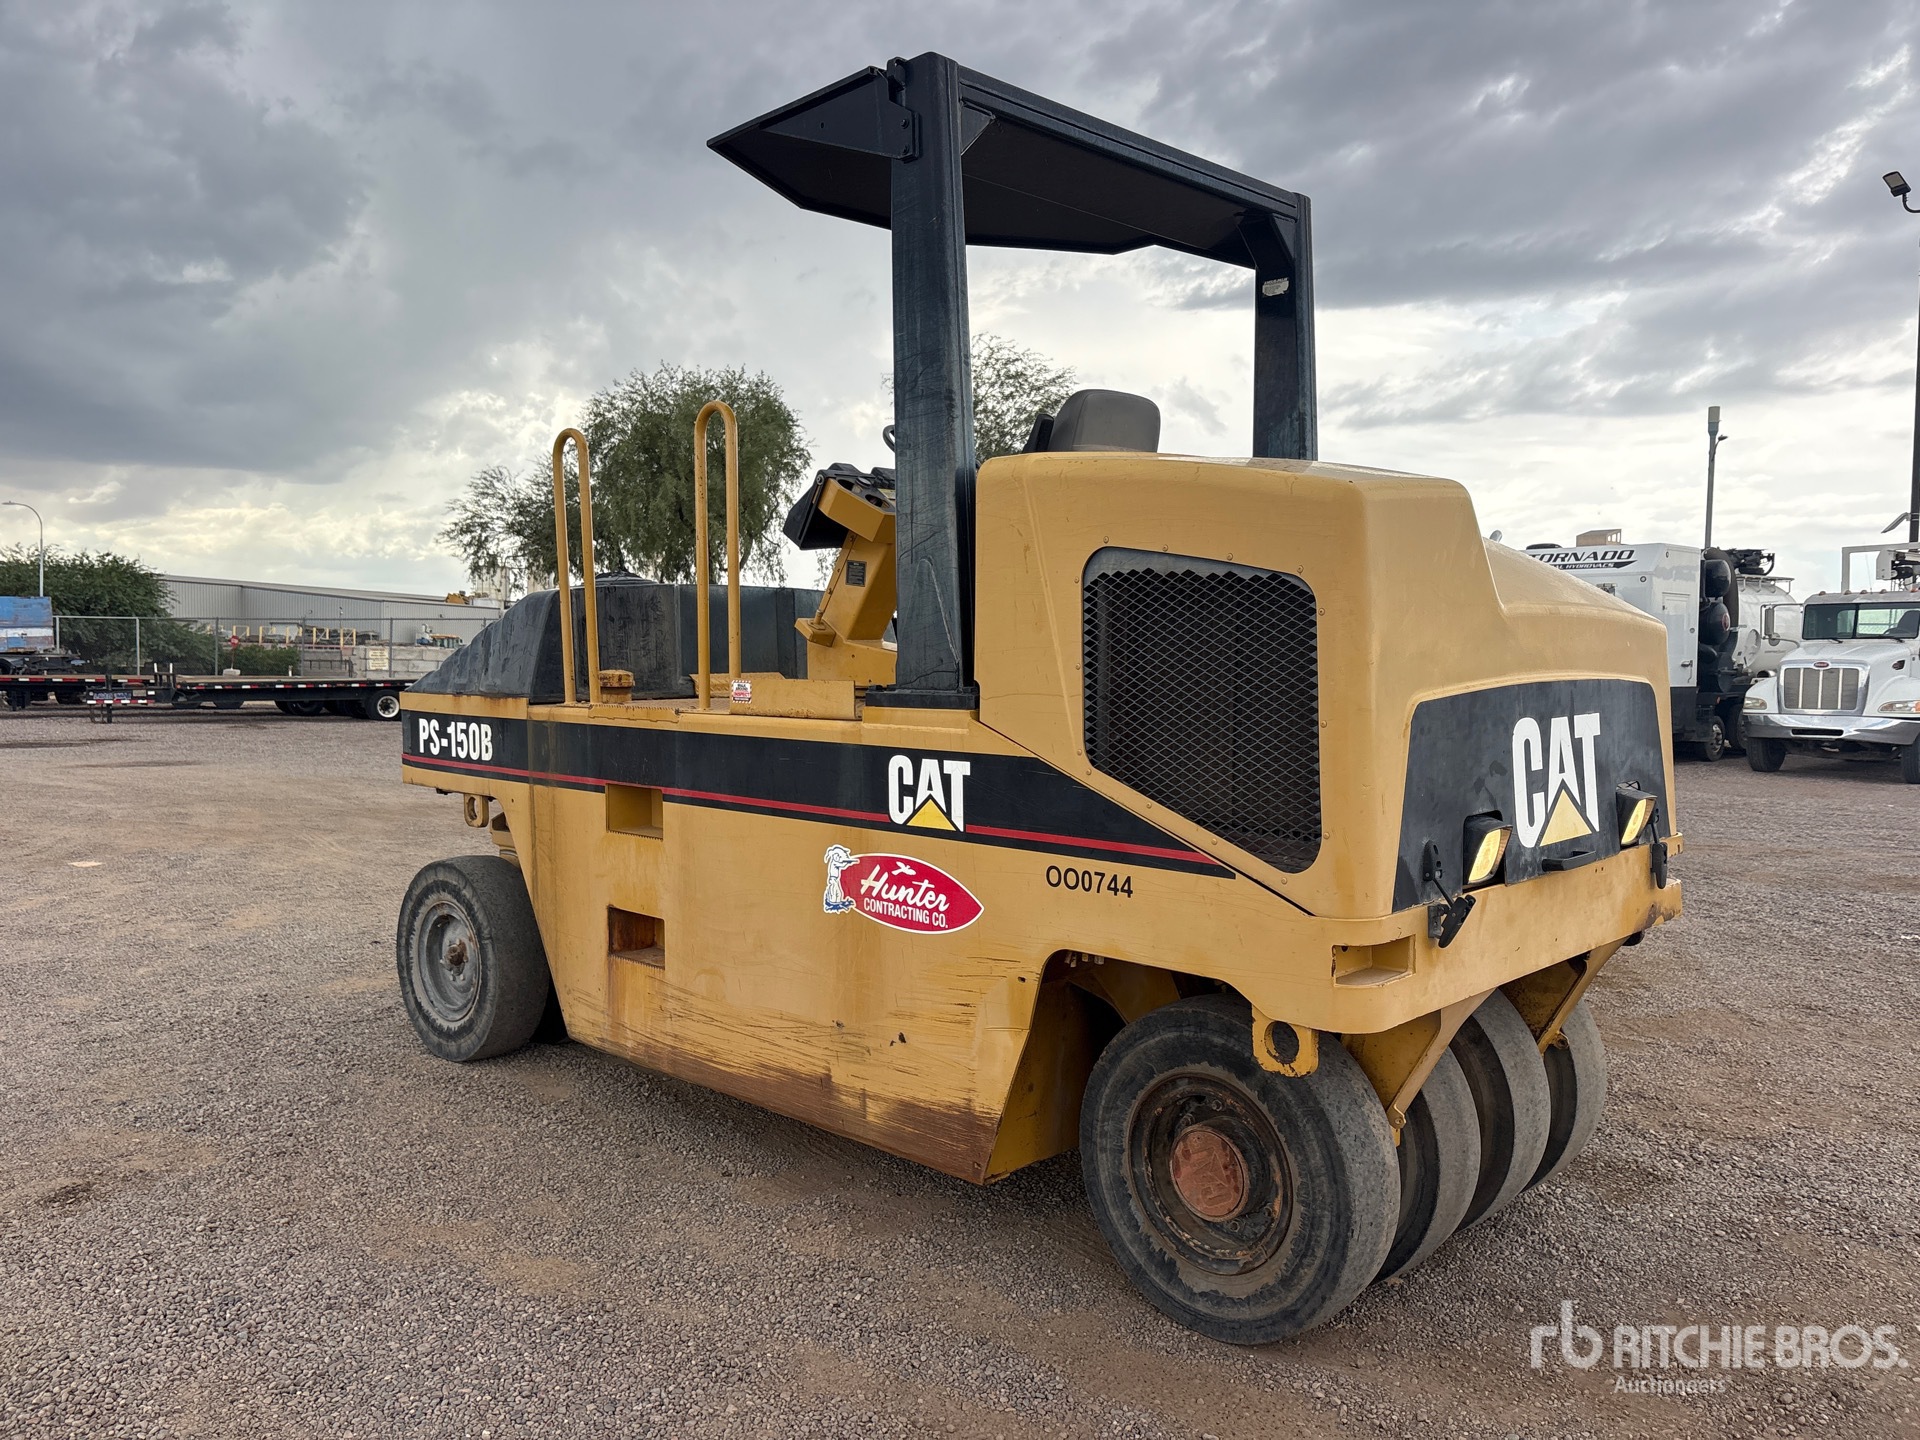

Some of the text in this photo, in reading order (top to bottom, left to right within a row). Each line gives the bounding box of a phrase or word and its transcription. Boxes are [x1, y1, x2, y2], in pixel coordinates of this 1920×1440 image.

[418, 718, 493, 761] PS-150B
[888, 755, 971, 832] CAT
[1512, 712, 1601, 848] CAT
[860, 864, 949, 911] Hunter
[863, 897, 949, 929] CONTRACTING CO.
